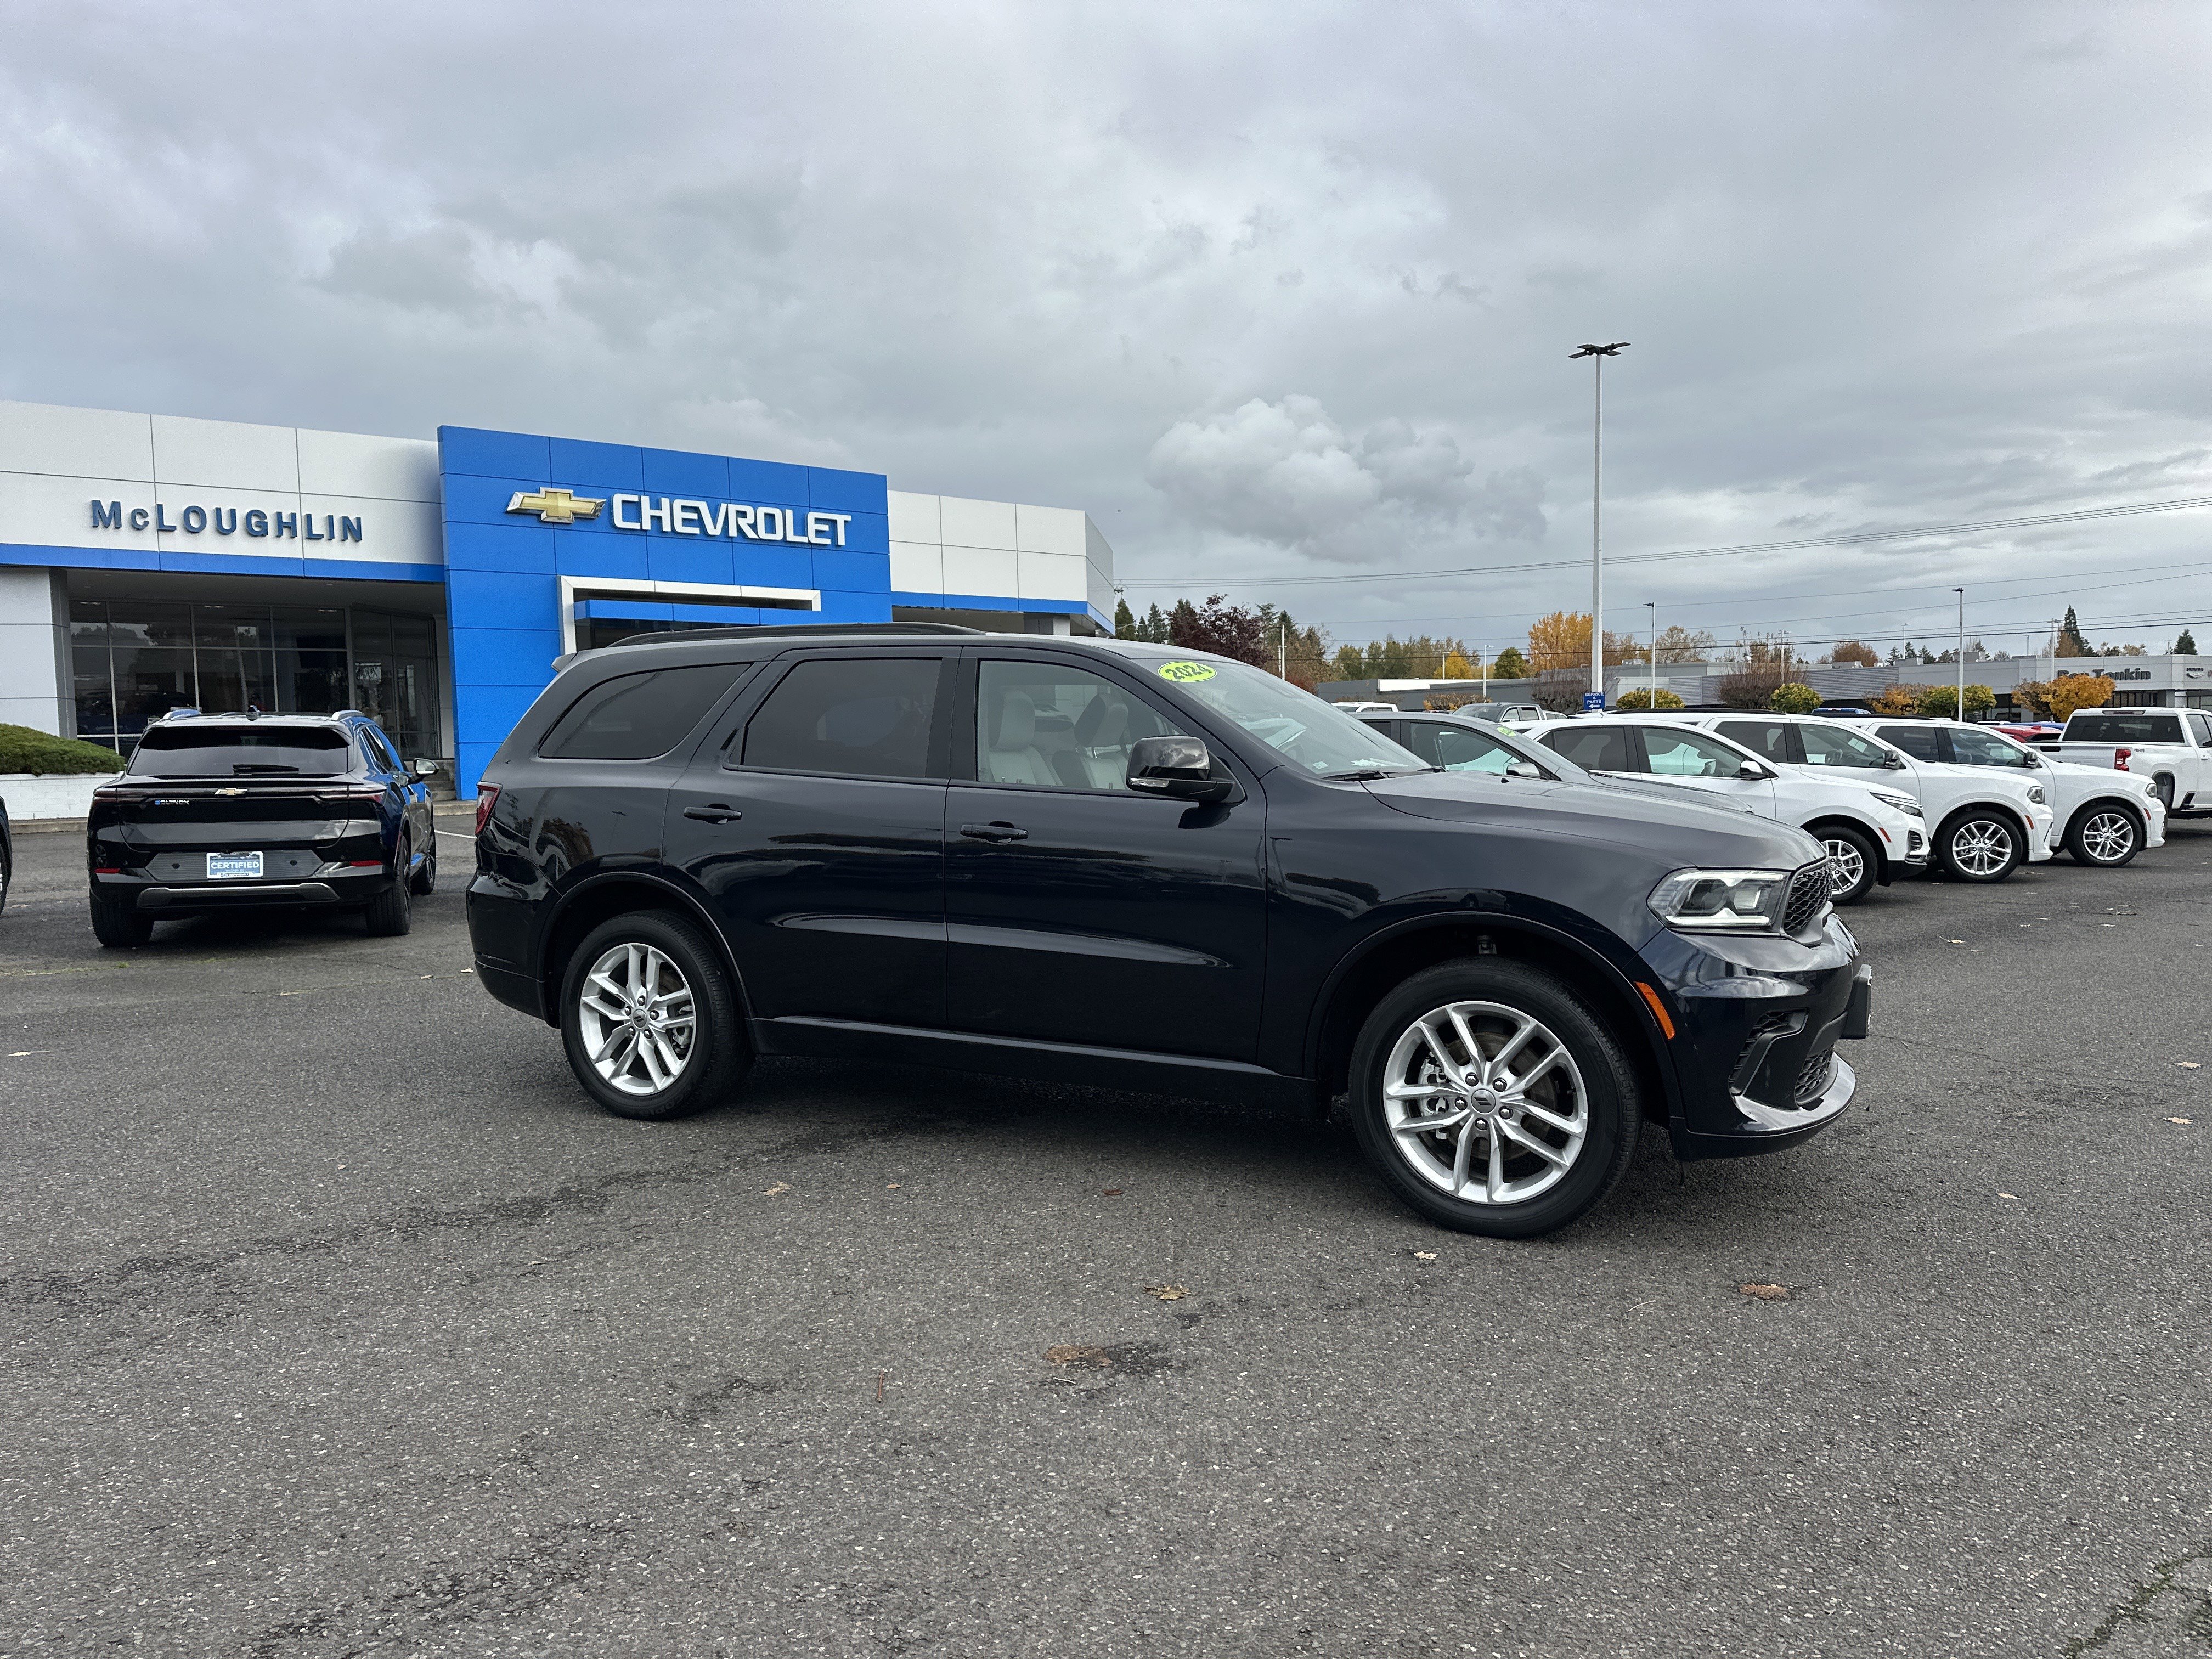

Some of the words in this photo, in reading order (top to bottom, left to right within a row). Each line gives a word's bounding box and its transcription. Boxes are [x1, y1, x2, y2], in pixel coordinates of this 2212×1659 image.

[91, 500, 362, 541] McLOUGHLIN
[613, 494, 851, 546] CHEVROLET
[1165, 664, 1213, 680] 2024
[2092, 668, 2151, 680] Tonkin
